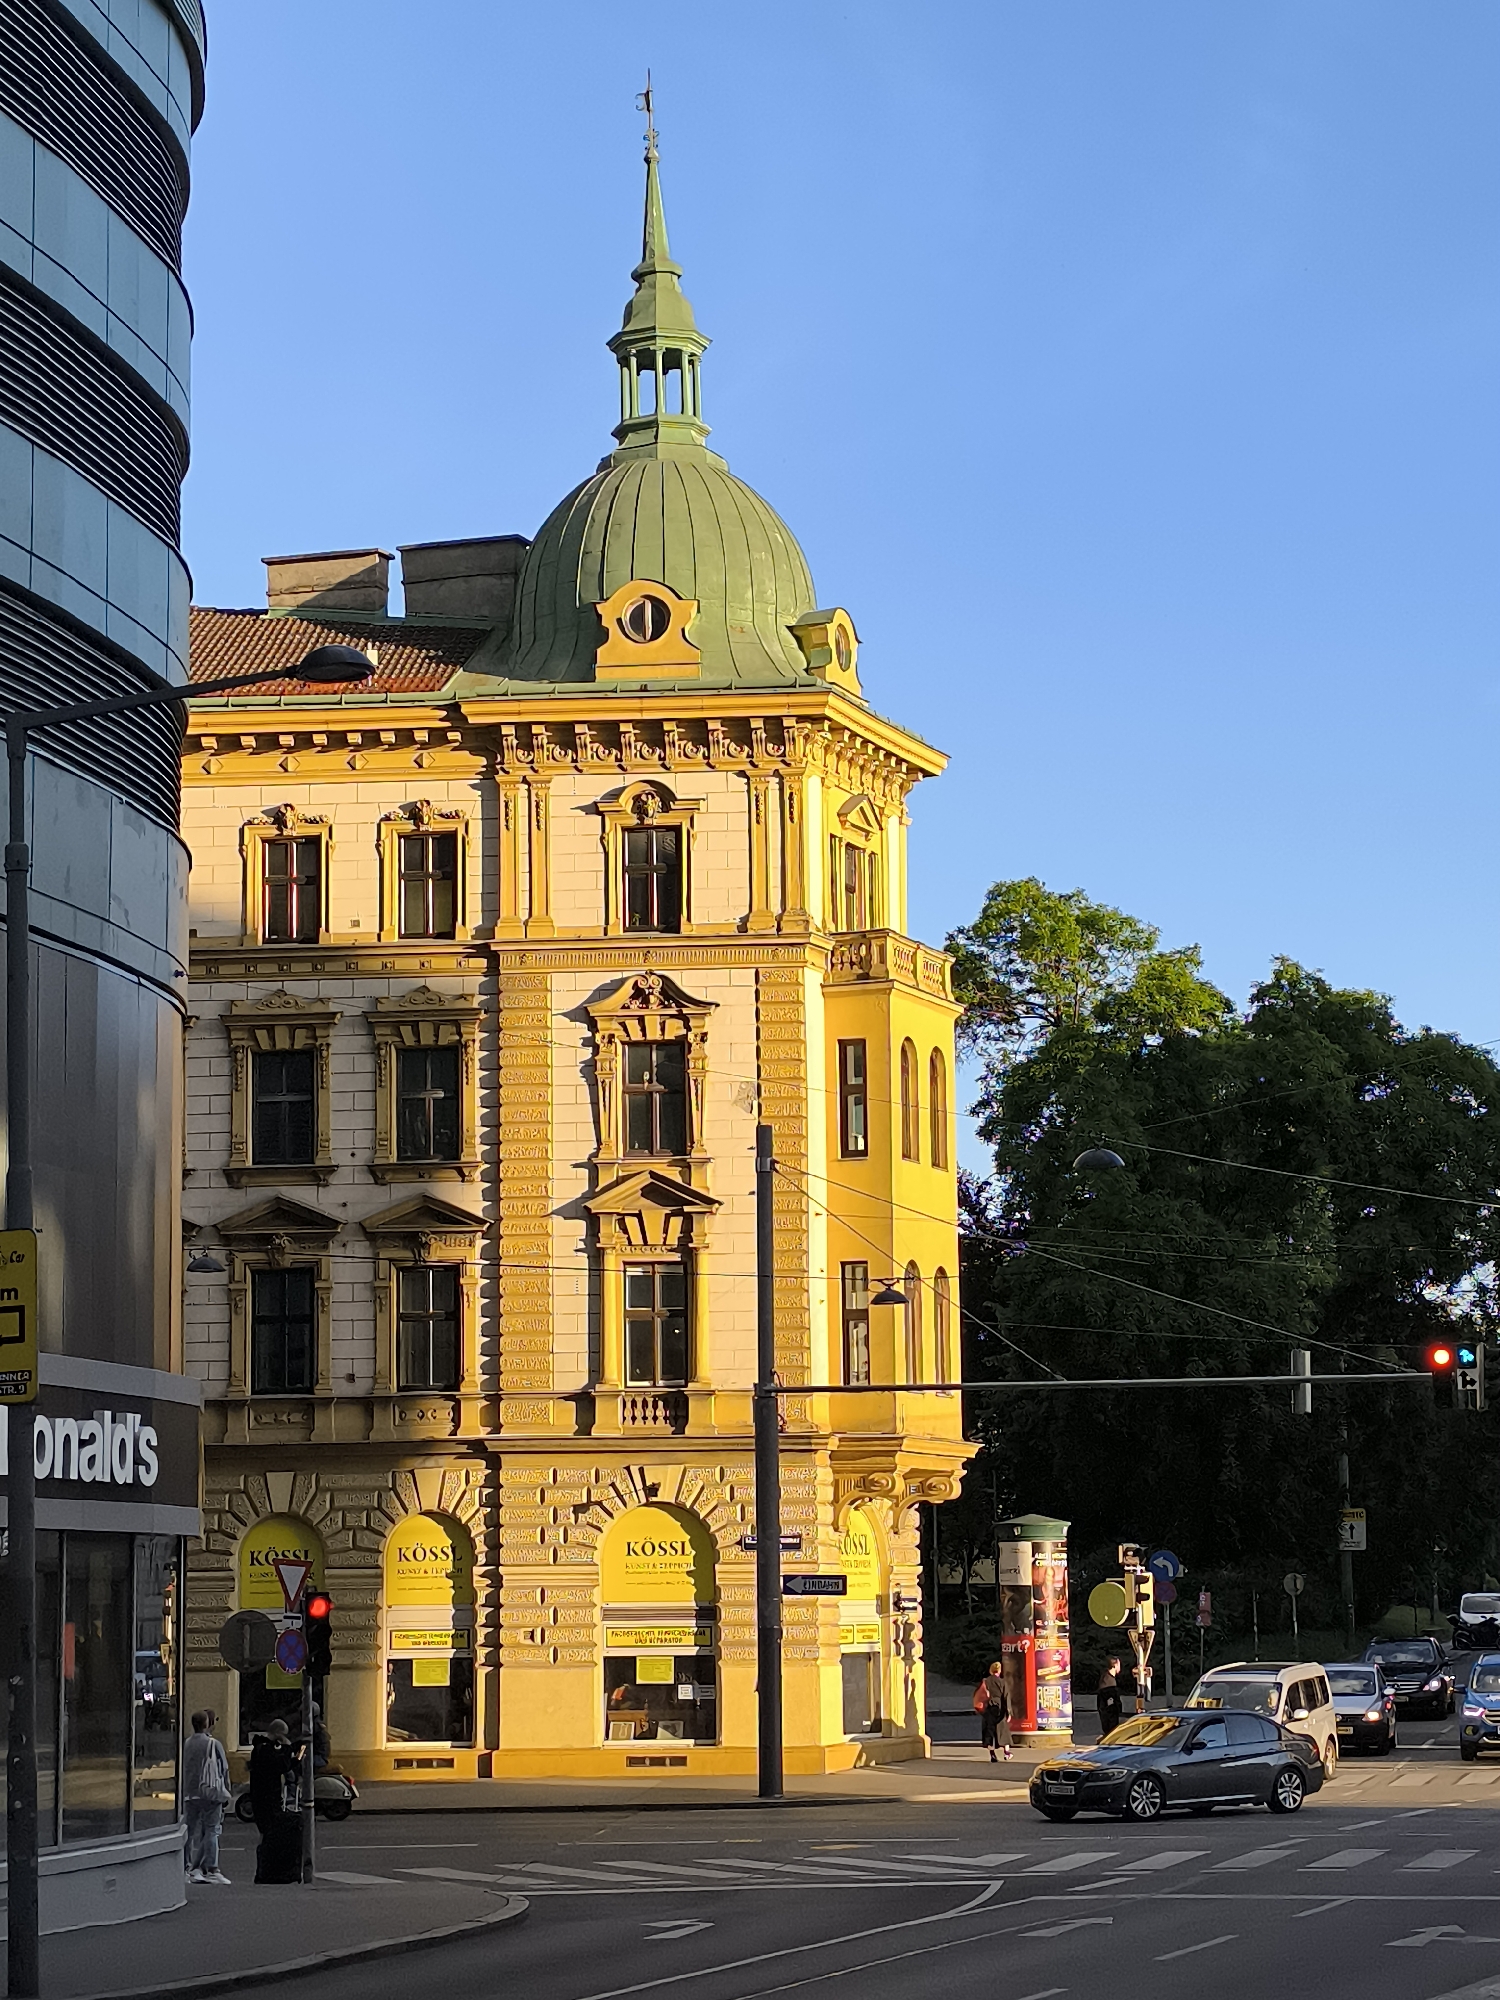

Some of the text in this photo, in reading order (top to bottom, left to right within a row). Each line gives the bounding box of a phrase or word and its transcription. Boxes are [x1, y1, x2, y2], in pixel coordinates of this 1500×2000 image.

[397, 1542, 463, 1563] KÖSSL
[626, 1536, 692, 1557] KÖSSL
[803, 1580, 840, 1590] EINBAHN
